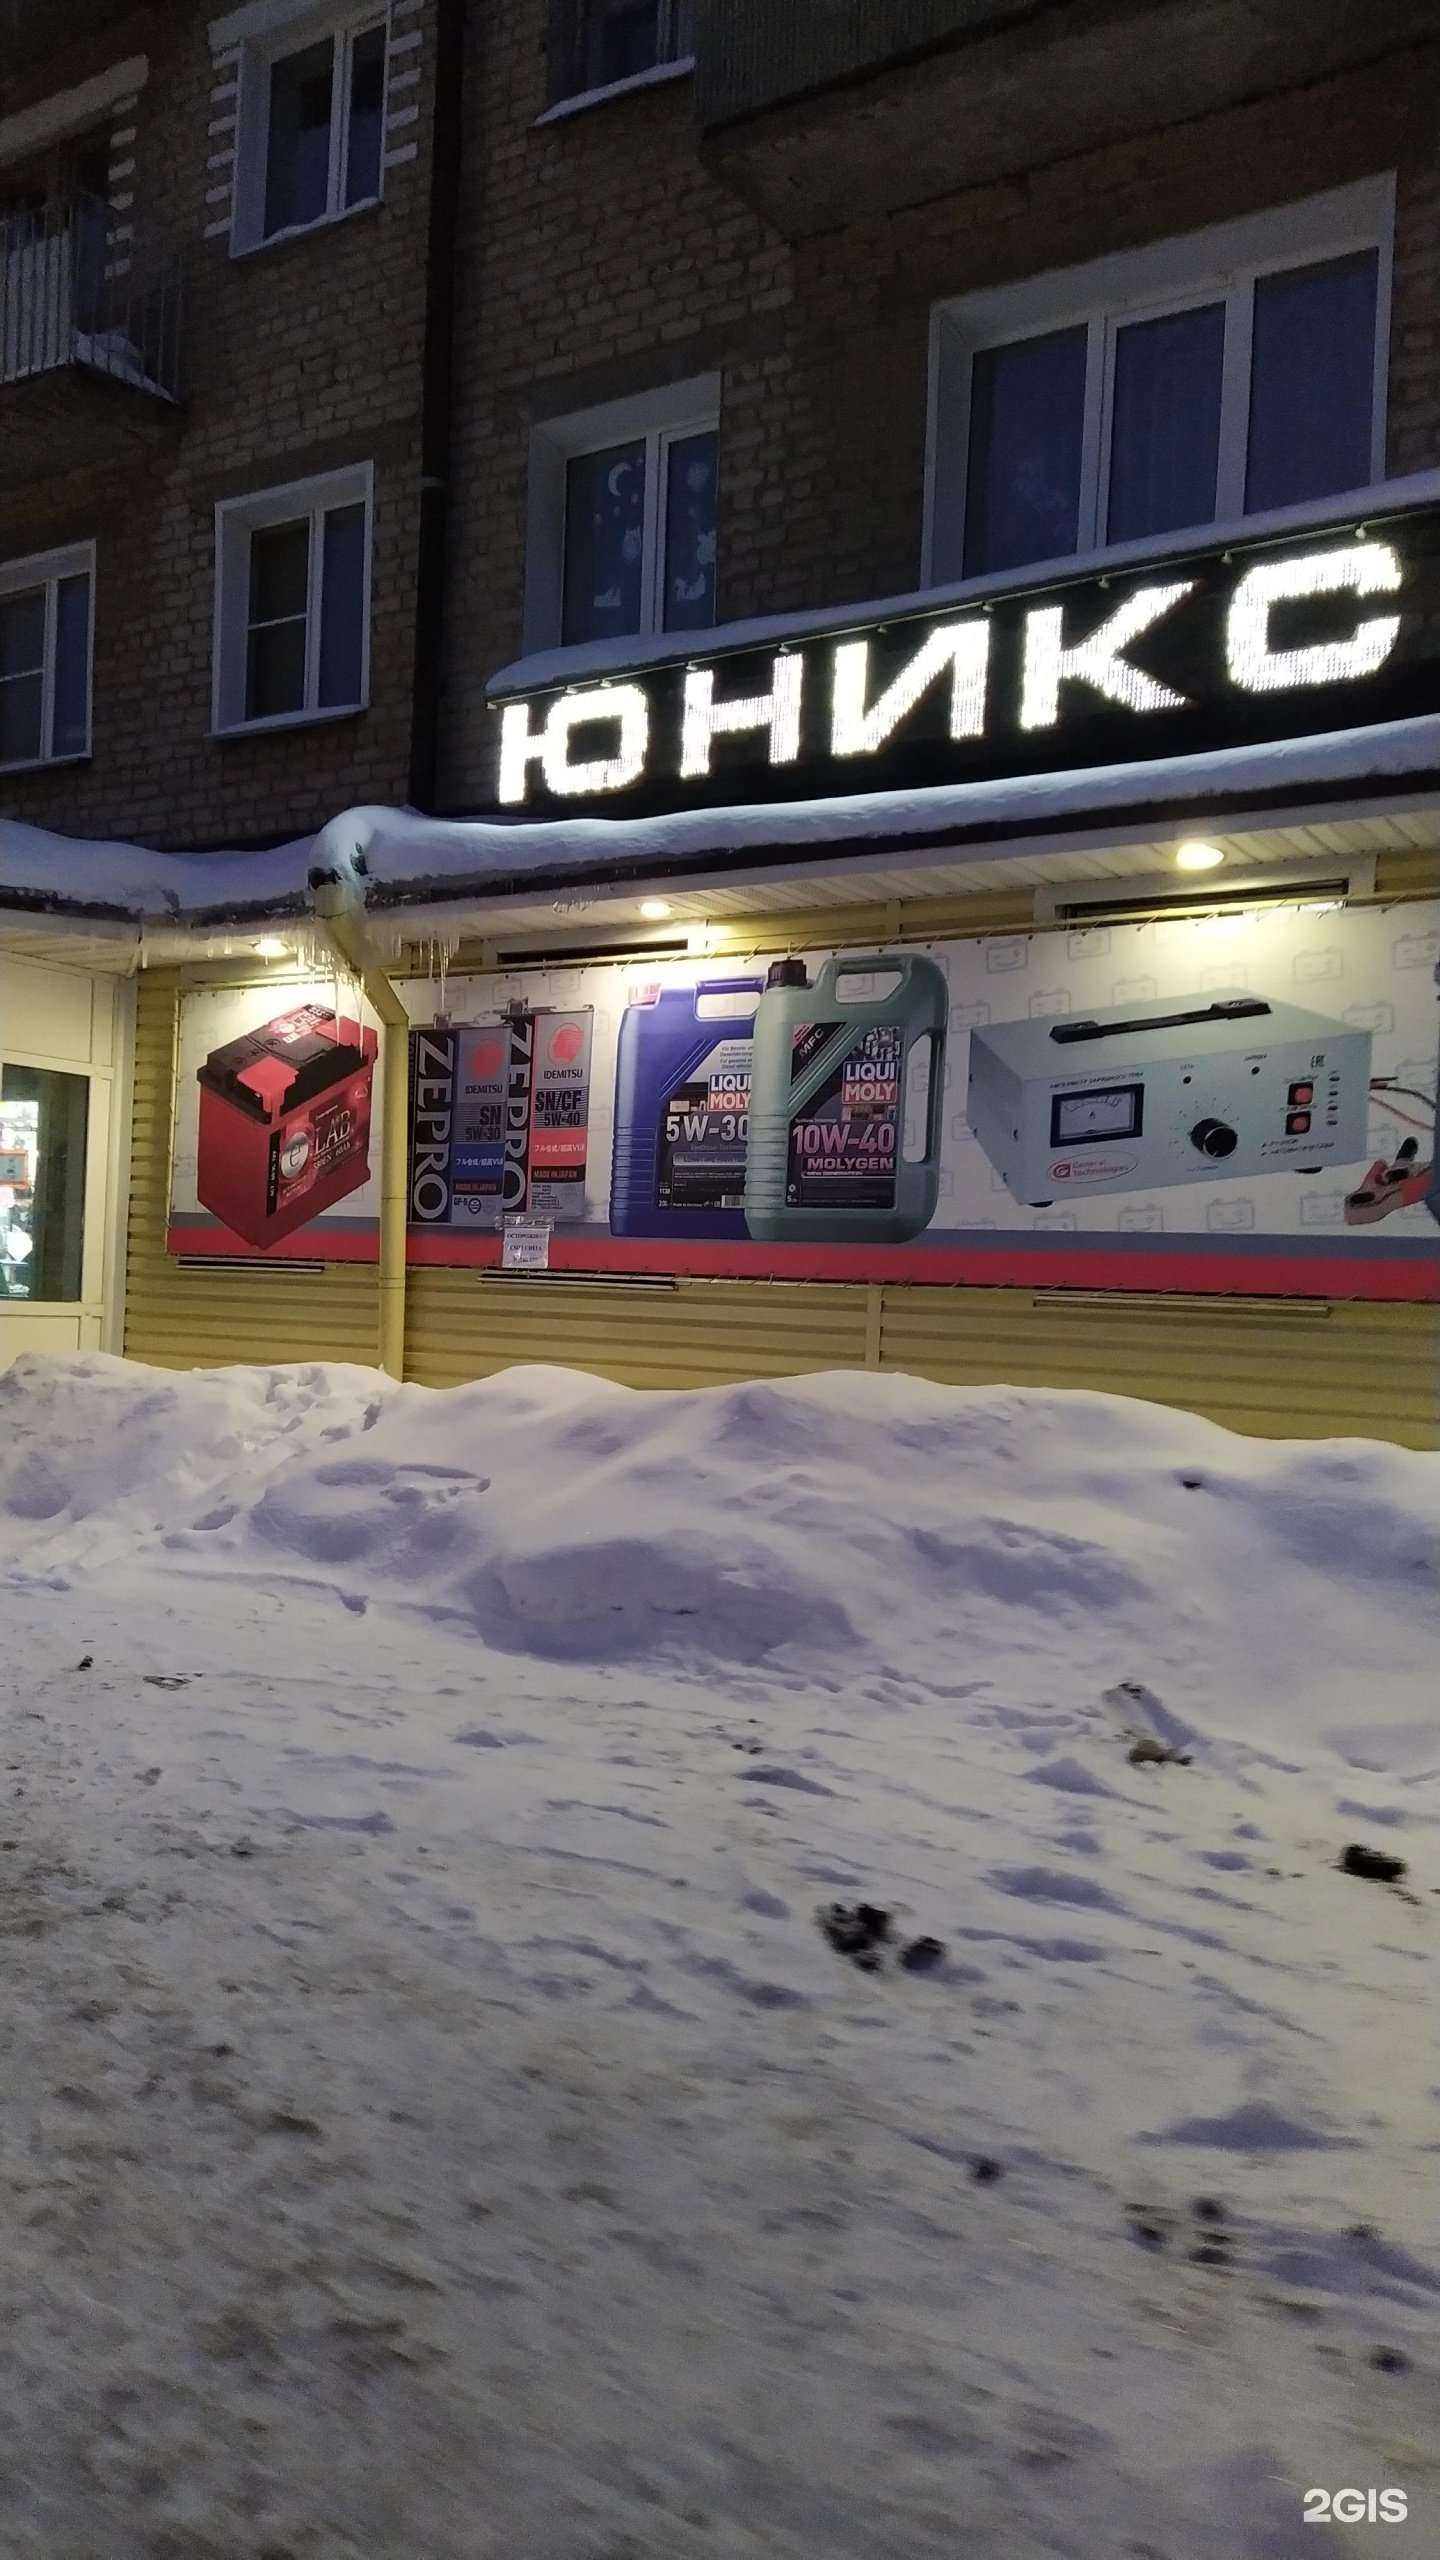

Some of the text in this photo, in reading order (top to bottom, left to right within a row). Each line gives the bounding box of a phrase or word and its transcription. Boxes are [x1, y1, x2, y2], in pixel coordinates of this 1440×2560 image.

[499, 541, 1401, 804] ЮНИКС
[799, 1028, 824, 1056] MFC
[543, 1069, 583, 1080] IDEMITSU
[846, 1062, 895, 1081] LIQUI
[465, 1084, 503, 1094] IDEMITSU
[844, 1083, 895, 1101] MOLY
[710, 1092, 751, 1109] MOLY
[479, 1105, 500, 1125] SN
[503, 1021, 531, 1209] ZEPRO
[544, 1112, 580, 1126] 5W-40
[315, 1110, 350, 1155] LAB
[414, 1035, 453, 1219] ZEPRO
[666, 1115, 749, 1141] 5W-30
[793, 1123, 895, 1154] 10W-40
[807, 1157, 894, 1170] MOLYGEN
